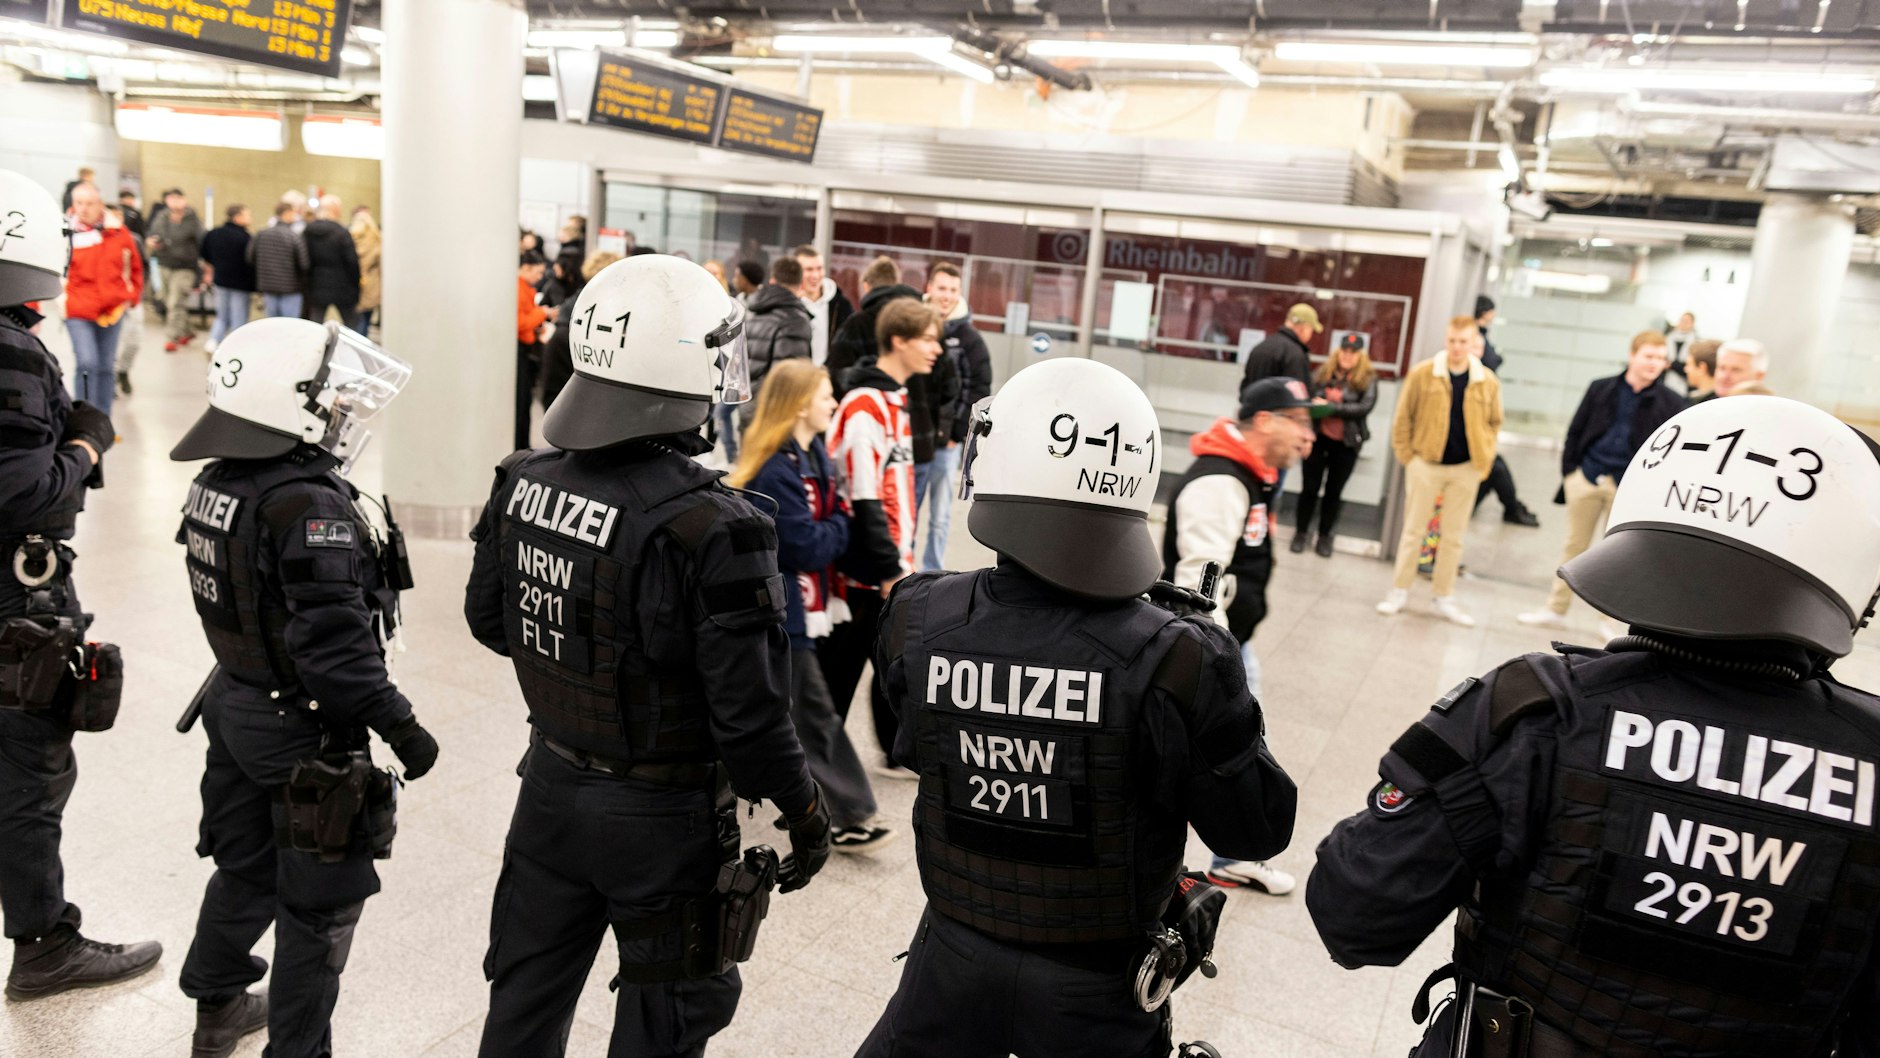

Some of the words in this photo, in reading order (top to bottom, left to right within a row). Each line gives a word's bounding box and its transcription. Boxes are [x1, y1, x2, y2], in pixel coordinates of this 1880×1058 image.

[231, 9, 270, 32] Nord
[289, 21, 318, 42] Min
[287, 39, 316, 59] Min
[1109, 237, 1257, 277] Rheinbahn
[573, 341, 614, 368] NRW
[1047, 413, 1155, 474] 9-1-1
[1643, 424, 1823, 501] 9-1-3
[1076, 467, 1142, 498] NRW
[1664, 479, 1770, 527] NRW
[184, 482, 239, 533] OLIZEI
[506, 477, 619, 548] POLIZEI
[190, 566, 218, 603] 933
[517, 540, 574, 591] NRW
[519, 580, 563, 627] 2911
[521, 616, 565, 662] FLT
[926, 655, 1103, 723] POLIZEI
[959, 729, 1056, 775] NRW
[1605, 710, 1875, 826] POLIZEI
[968, 774, 1048, 820] 2911
[1644, 811, 1807, 886] NRW
[1633, 871, 1774, 942] 2913
